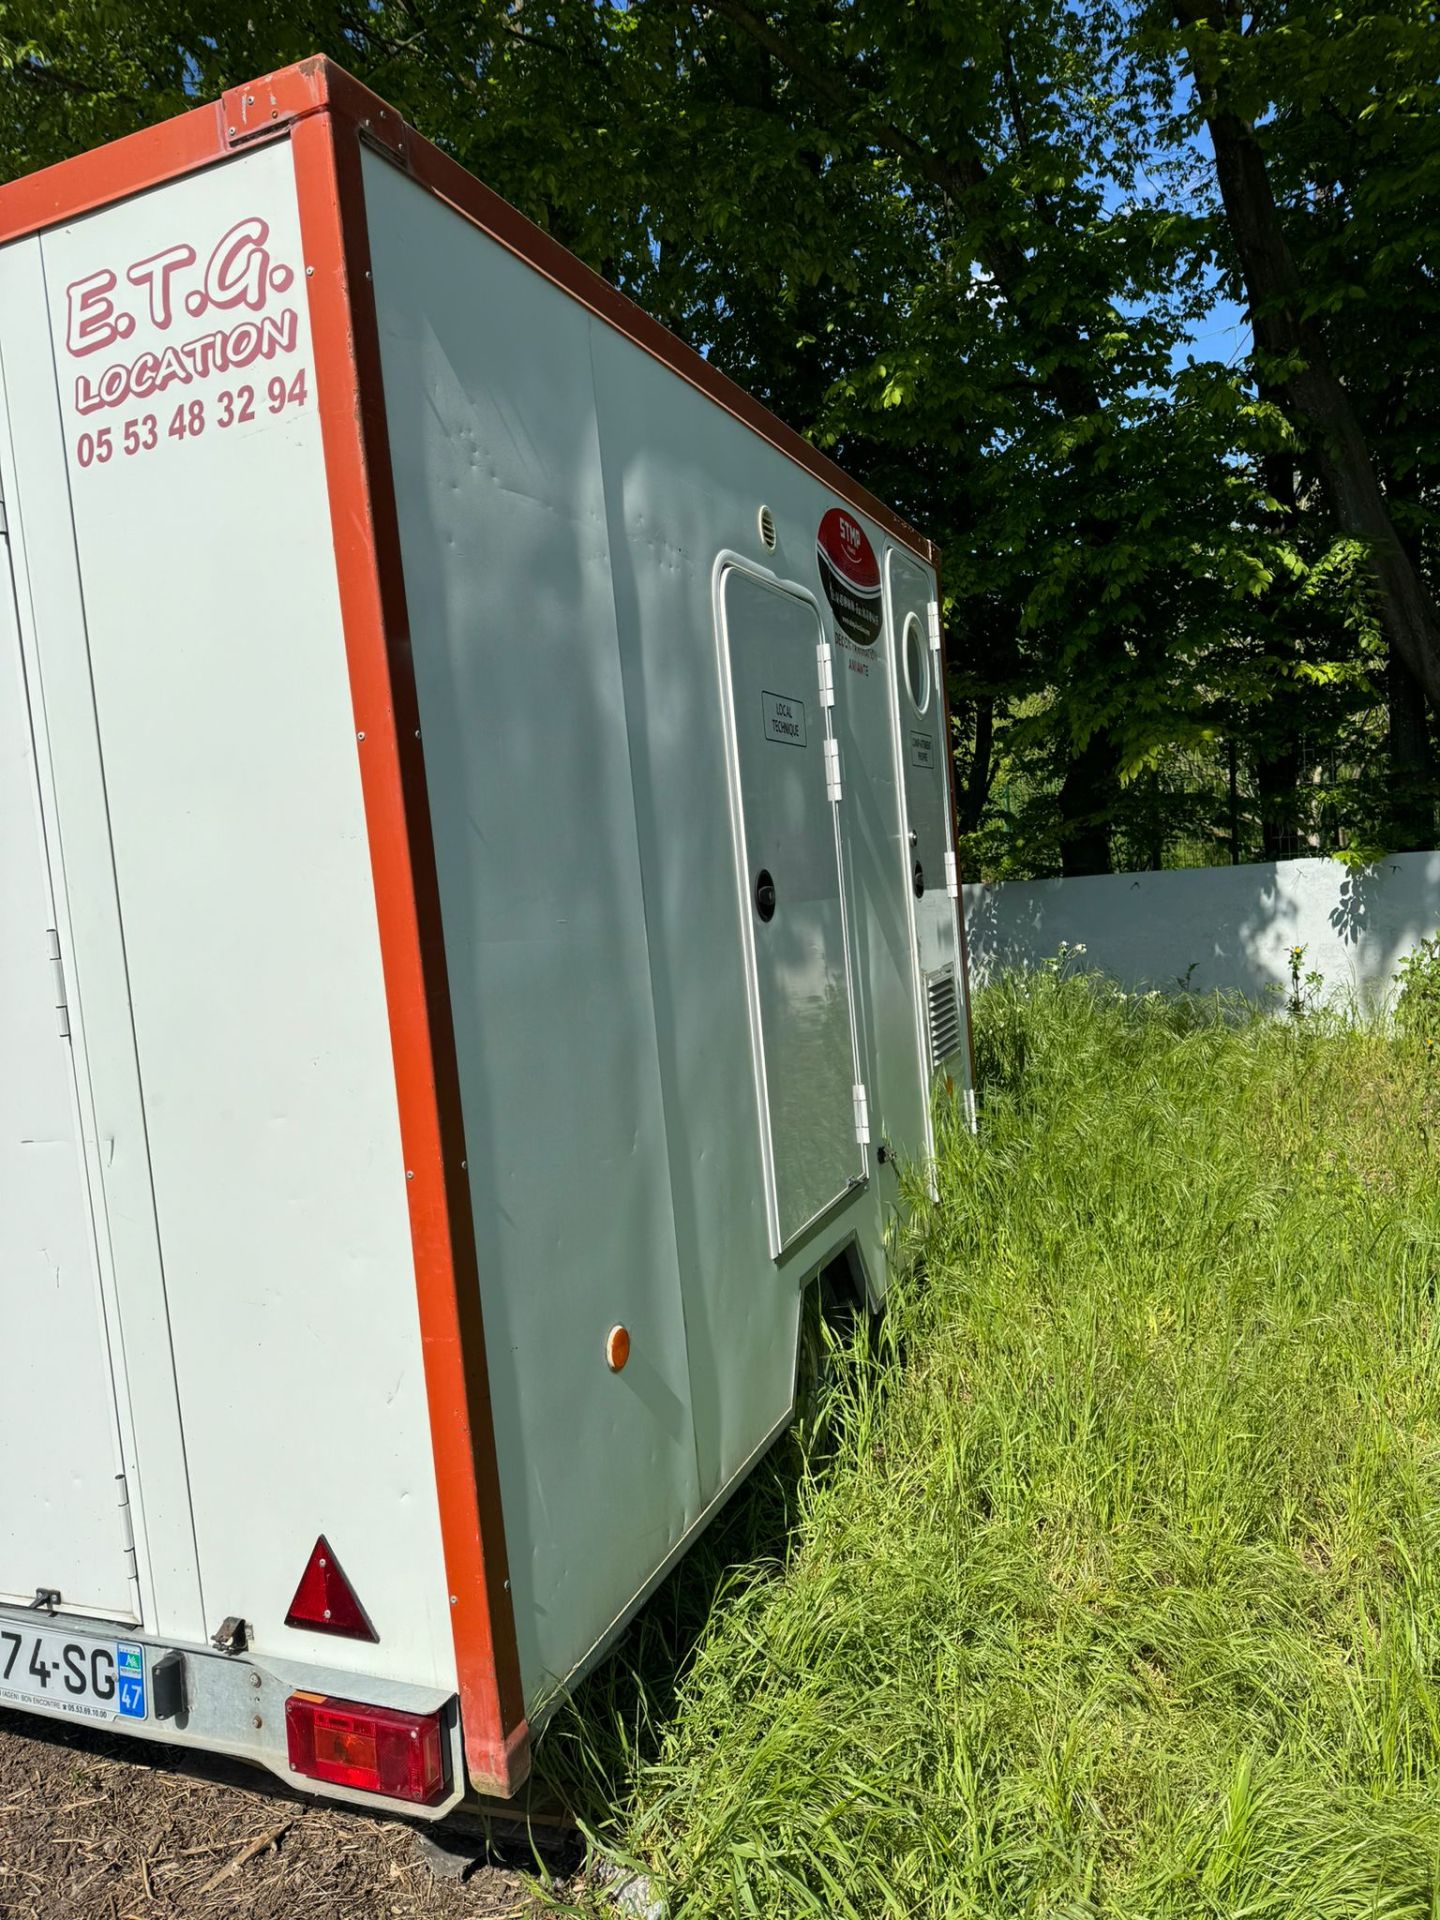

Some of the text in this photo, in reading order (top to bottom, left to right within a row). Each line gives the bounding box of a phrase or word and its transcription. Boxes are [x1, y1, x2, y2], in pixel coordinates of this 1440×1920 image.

[66, 216, 294, 358] E.T.G.
[75, 308, 298, 416] LOCATION
[77, 368, 308, 468] 05 53 48 32 94
[772, 718, 799, 737] TECHNIQUE
[776, 702, 793, 718] LOCAL
[122, 1683, 142, 1709] 47
